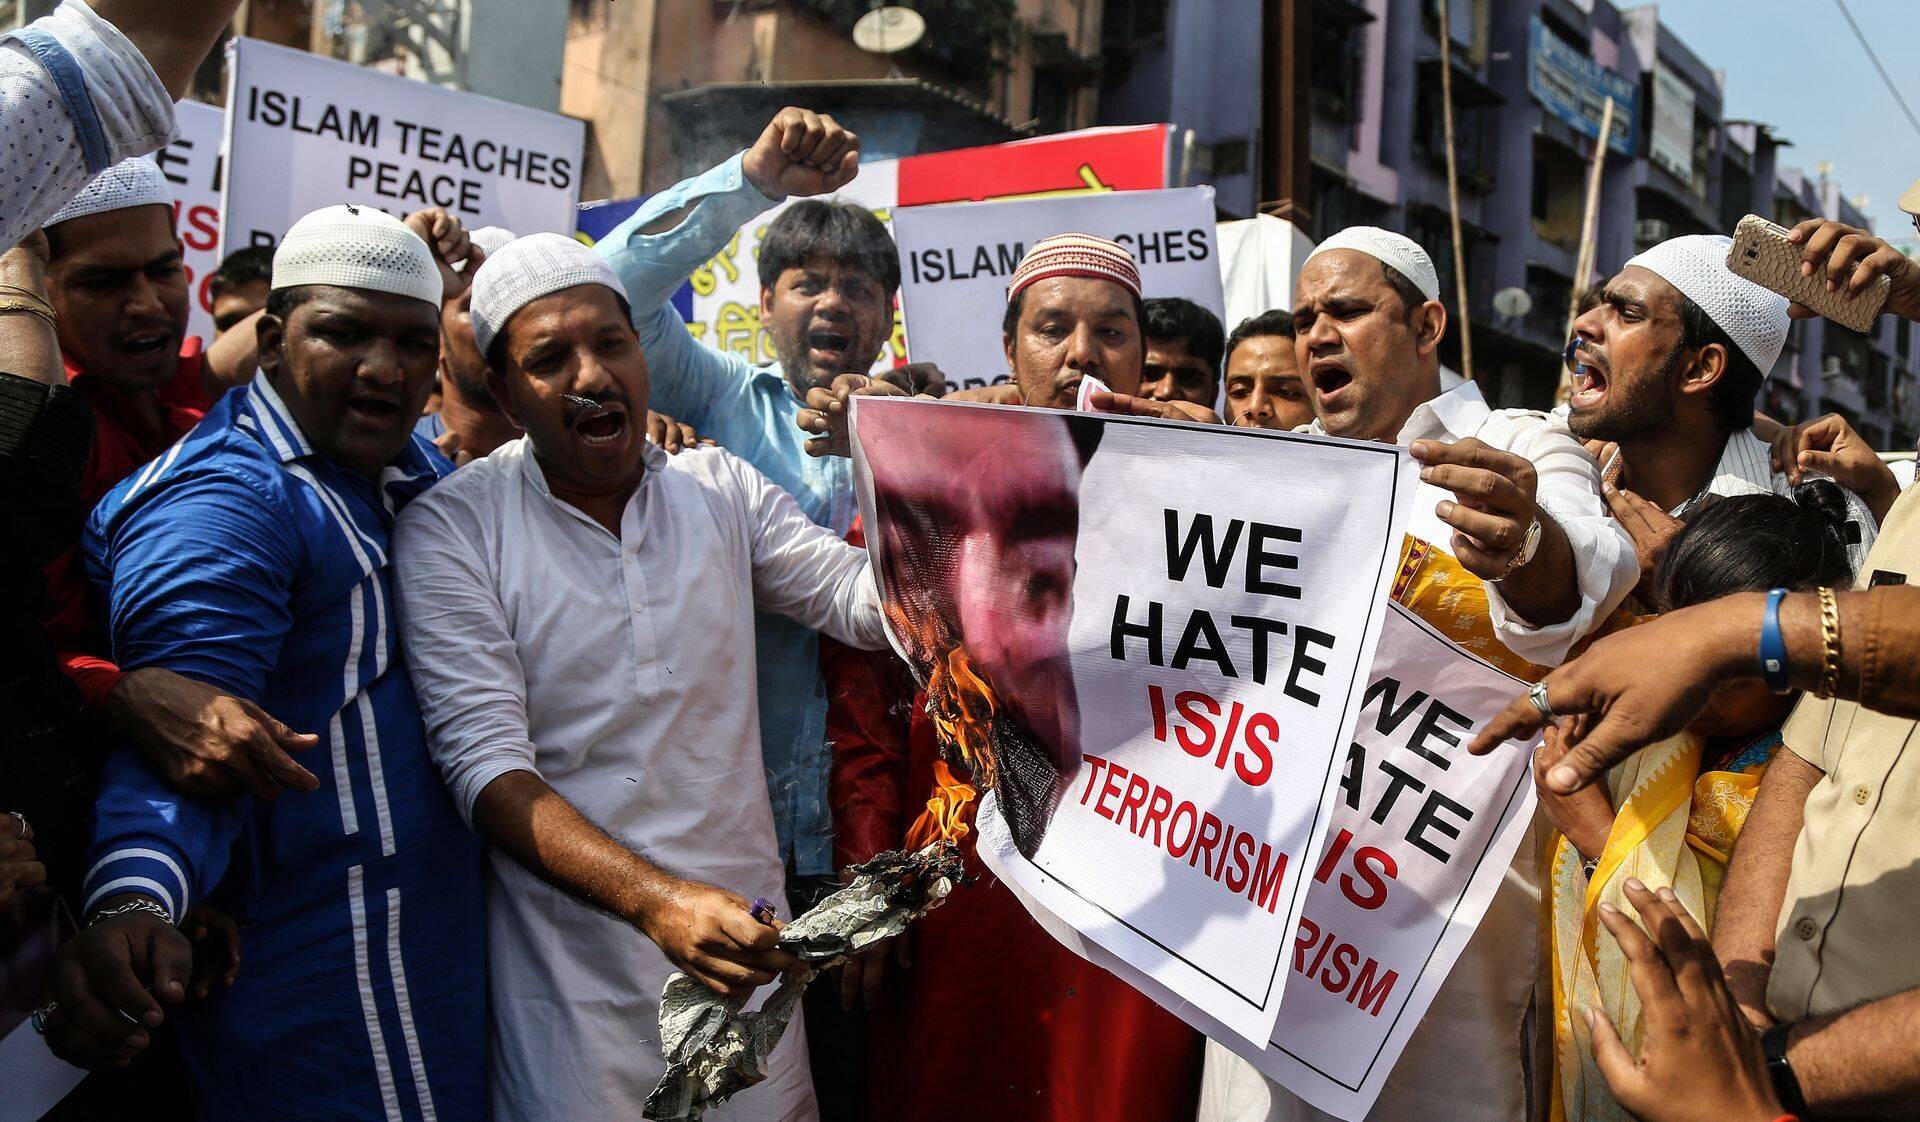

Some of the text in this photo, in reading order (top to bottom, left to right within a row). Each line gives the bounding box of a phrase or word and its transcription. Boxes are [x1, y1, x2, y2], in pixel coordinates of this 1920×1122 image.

[247, 86, 571, 189] ISLAM TEACHES
[347, 157, 482, 214] PEACE
[909, 242, 1024, 284] ISLAM
[1164, 508, 1302, 600] WE
[1110, 594, 1336, 708] HATE
[1148, 684, 1280, 787] ISIS
[1080, 754, 1289, 914] TERRORISM
[1341, 742, 1475, 864] ATE
[1315, 828, 1399, 910] IS
